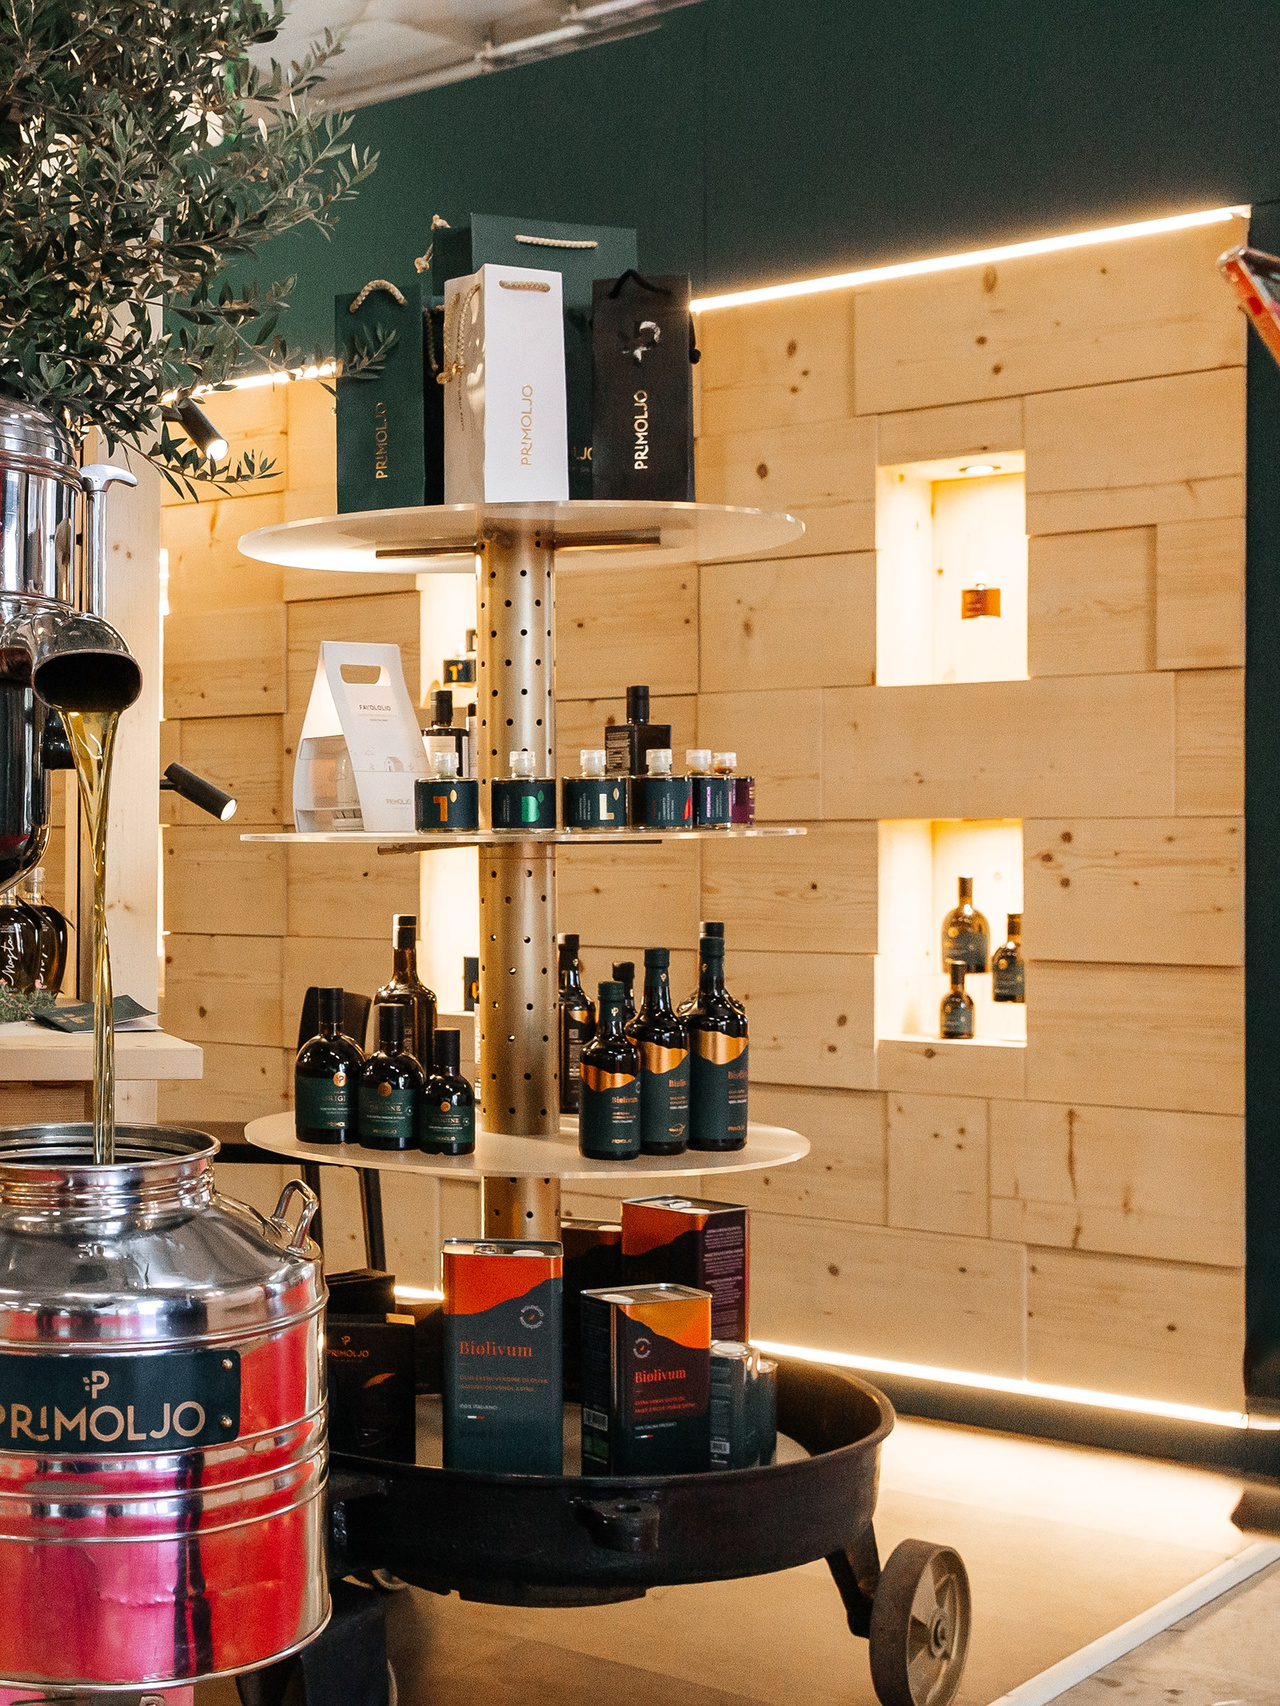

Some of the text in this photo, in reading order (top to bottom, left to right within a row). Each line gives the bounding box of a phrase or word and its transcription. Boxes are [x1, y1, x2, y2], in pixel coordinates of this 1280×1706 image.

[375, 401, 388, 480] PRIMOLJO
[520, 384, 534, 466] PRIMOLJO
[633, 389, 649, 470] PRIMOLJO
